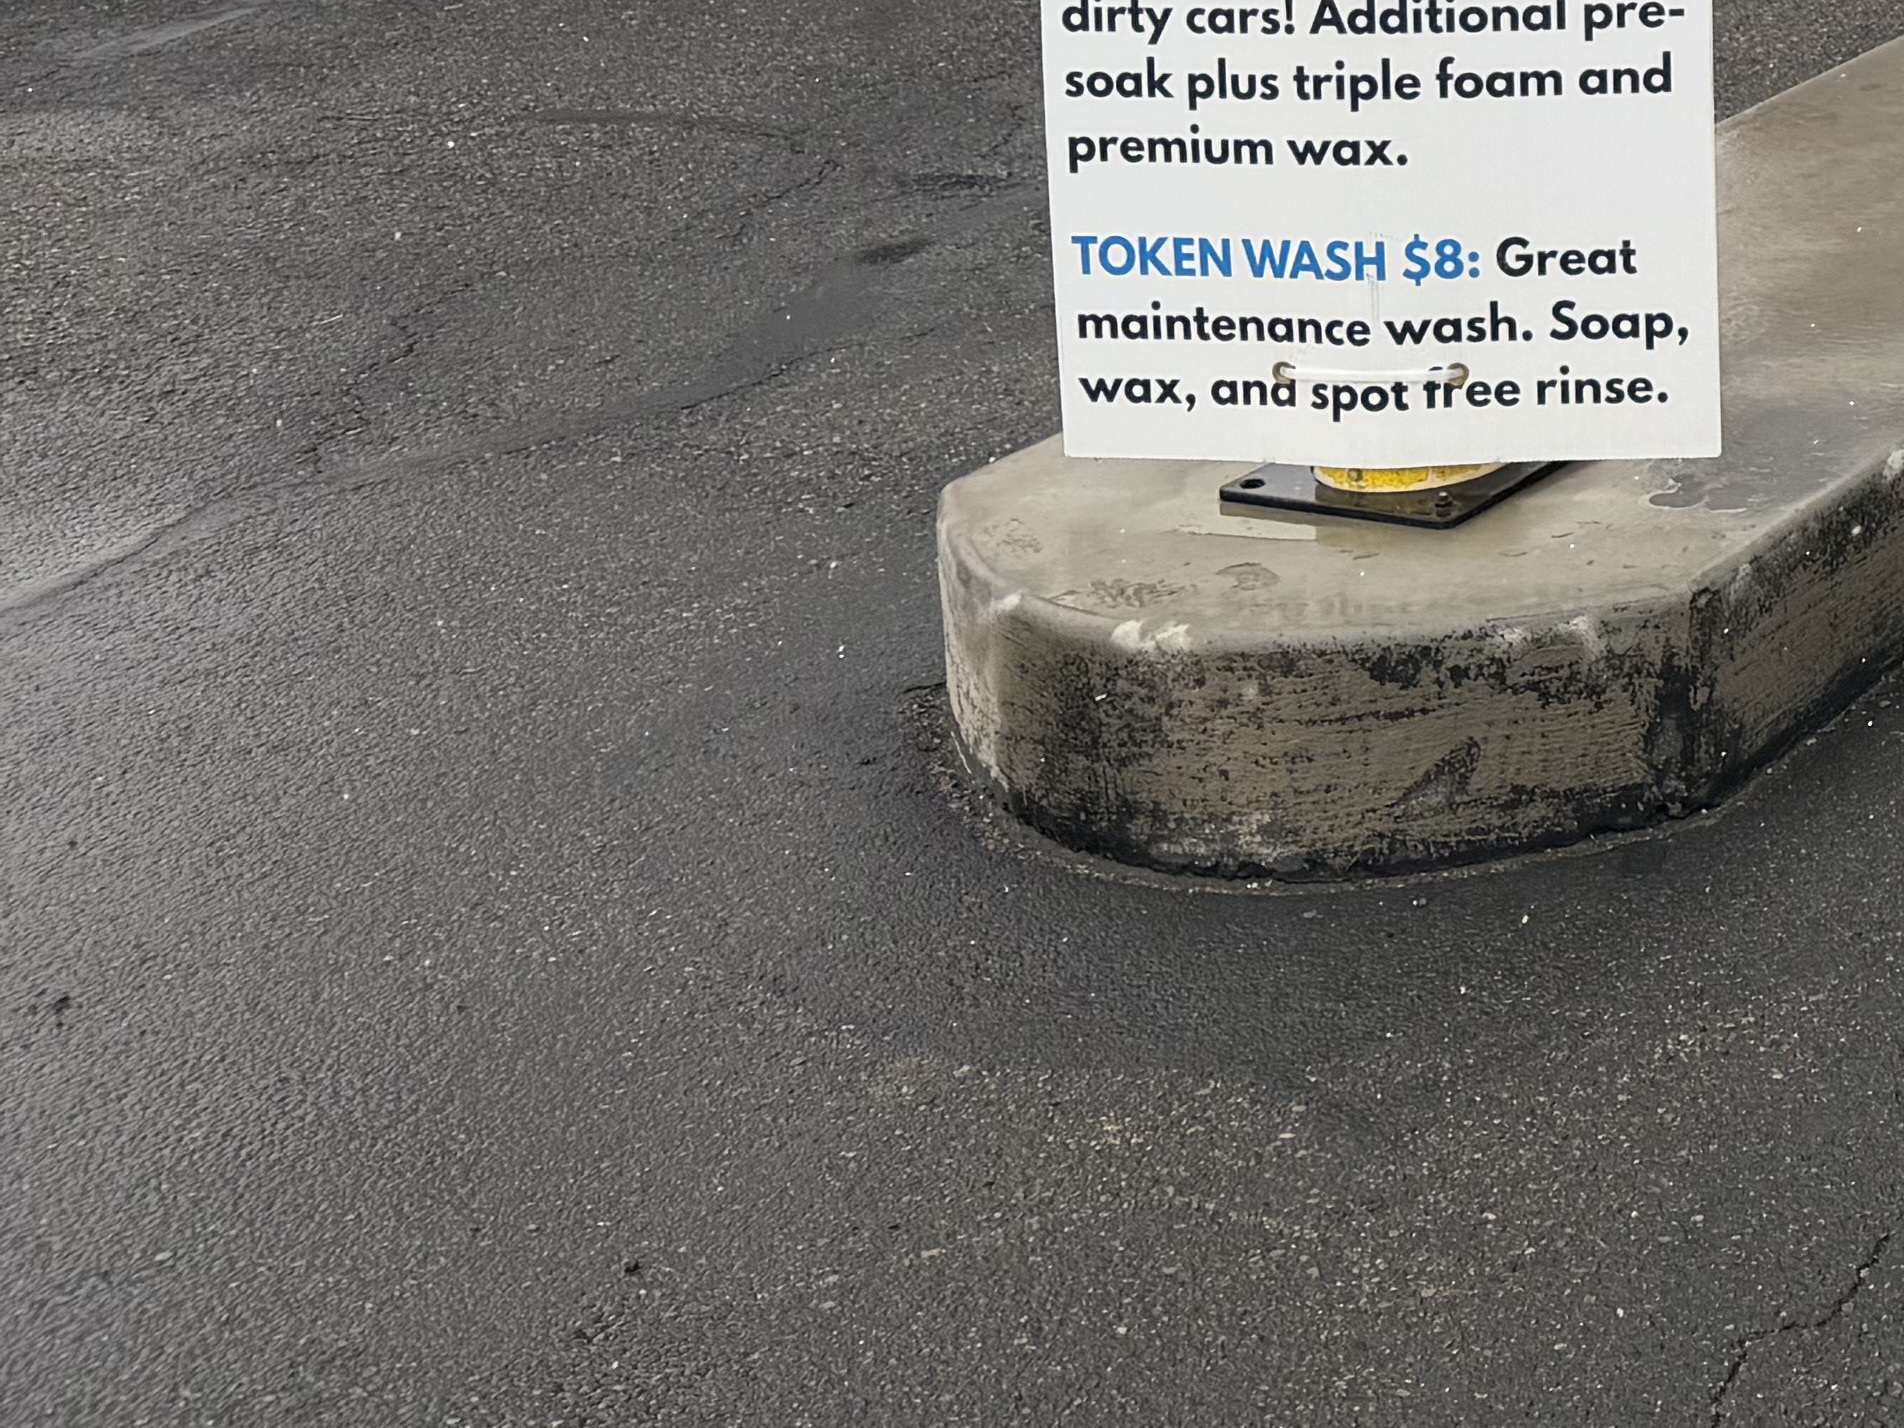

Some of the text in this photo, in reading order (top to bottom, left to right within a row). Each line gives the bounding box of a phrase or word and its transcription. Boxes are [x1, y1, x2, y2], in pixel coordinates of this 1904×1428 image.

[1584, 2, 1684, 41] pre-
[1066, 51, 1671, 112] soak plus triple foam and
[1069, 124, 1407, 173] premium wax.
[1072, 234, 1637, 286] TOKEN WASH $8: Great
[1078, 300, 1688, 350] maintenance wash. Soap,
[1079, 378, 1195, 411] wax,
[1311, 382, 1409, 422] spot
[1537, 366, 1668, 404] rinse.
